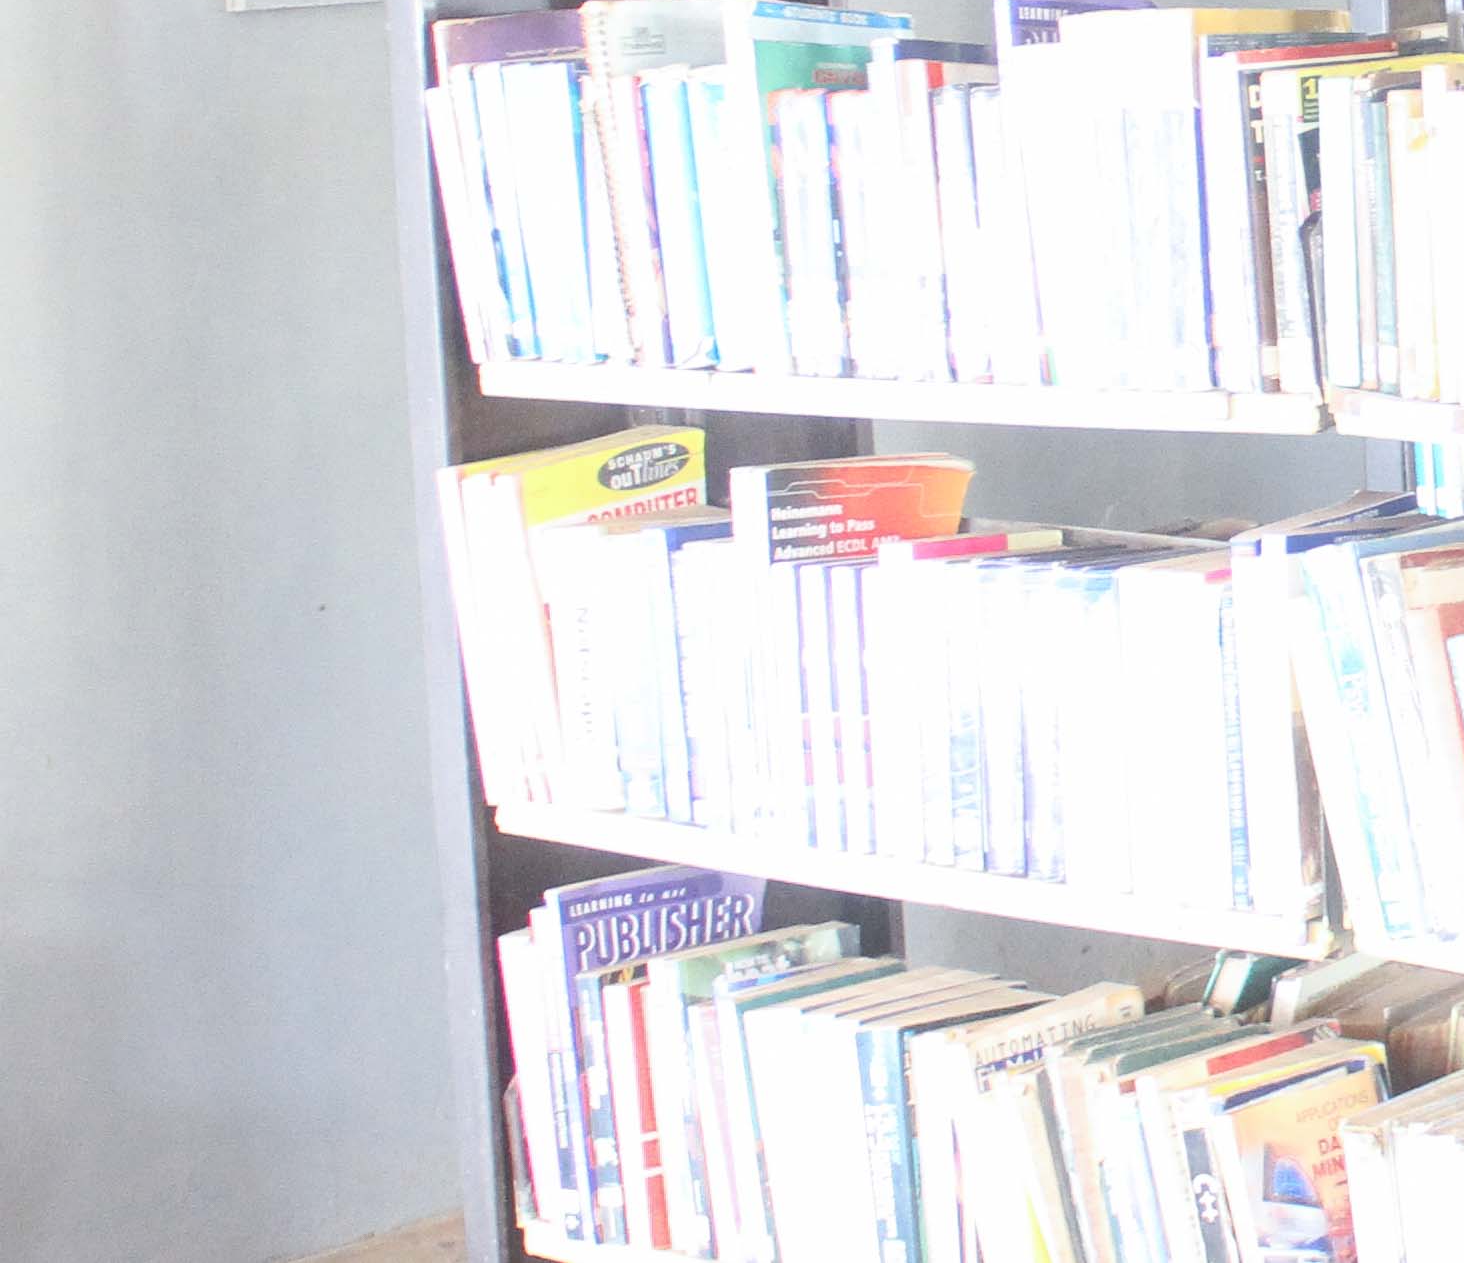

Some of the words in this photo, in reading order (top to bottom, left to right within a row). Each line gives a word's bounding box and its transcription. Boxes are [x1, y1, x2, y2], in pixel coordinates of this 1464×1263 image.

[607, 443, 678, 471] SCHAUM'S
[771, 503, 844, 522] Heinemann
[772, 523, 828, 540] Learning
[829, 521, 845, 534] to
[847, 518, 877, 533] Pass
[774, 540, 835, 561] Advanced
[836, 537, 869, 554] ECDL
[568, 893, 634, 918] LEARNING
[575, 893, 757, 973] PUBLISHER
[975, 1011, 1098, 1068] AUTOMATING
